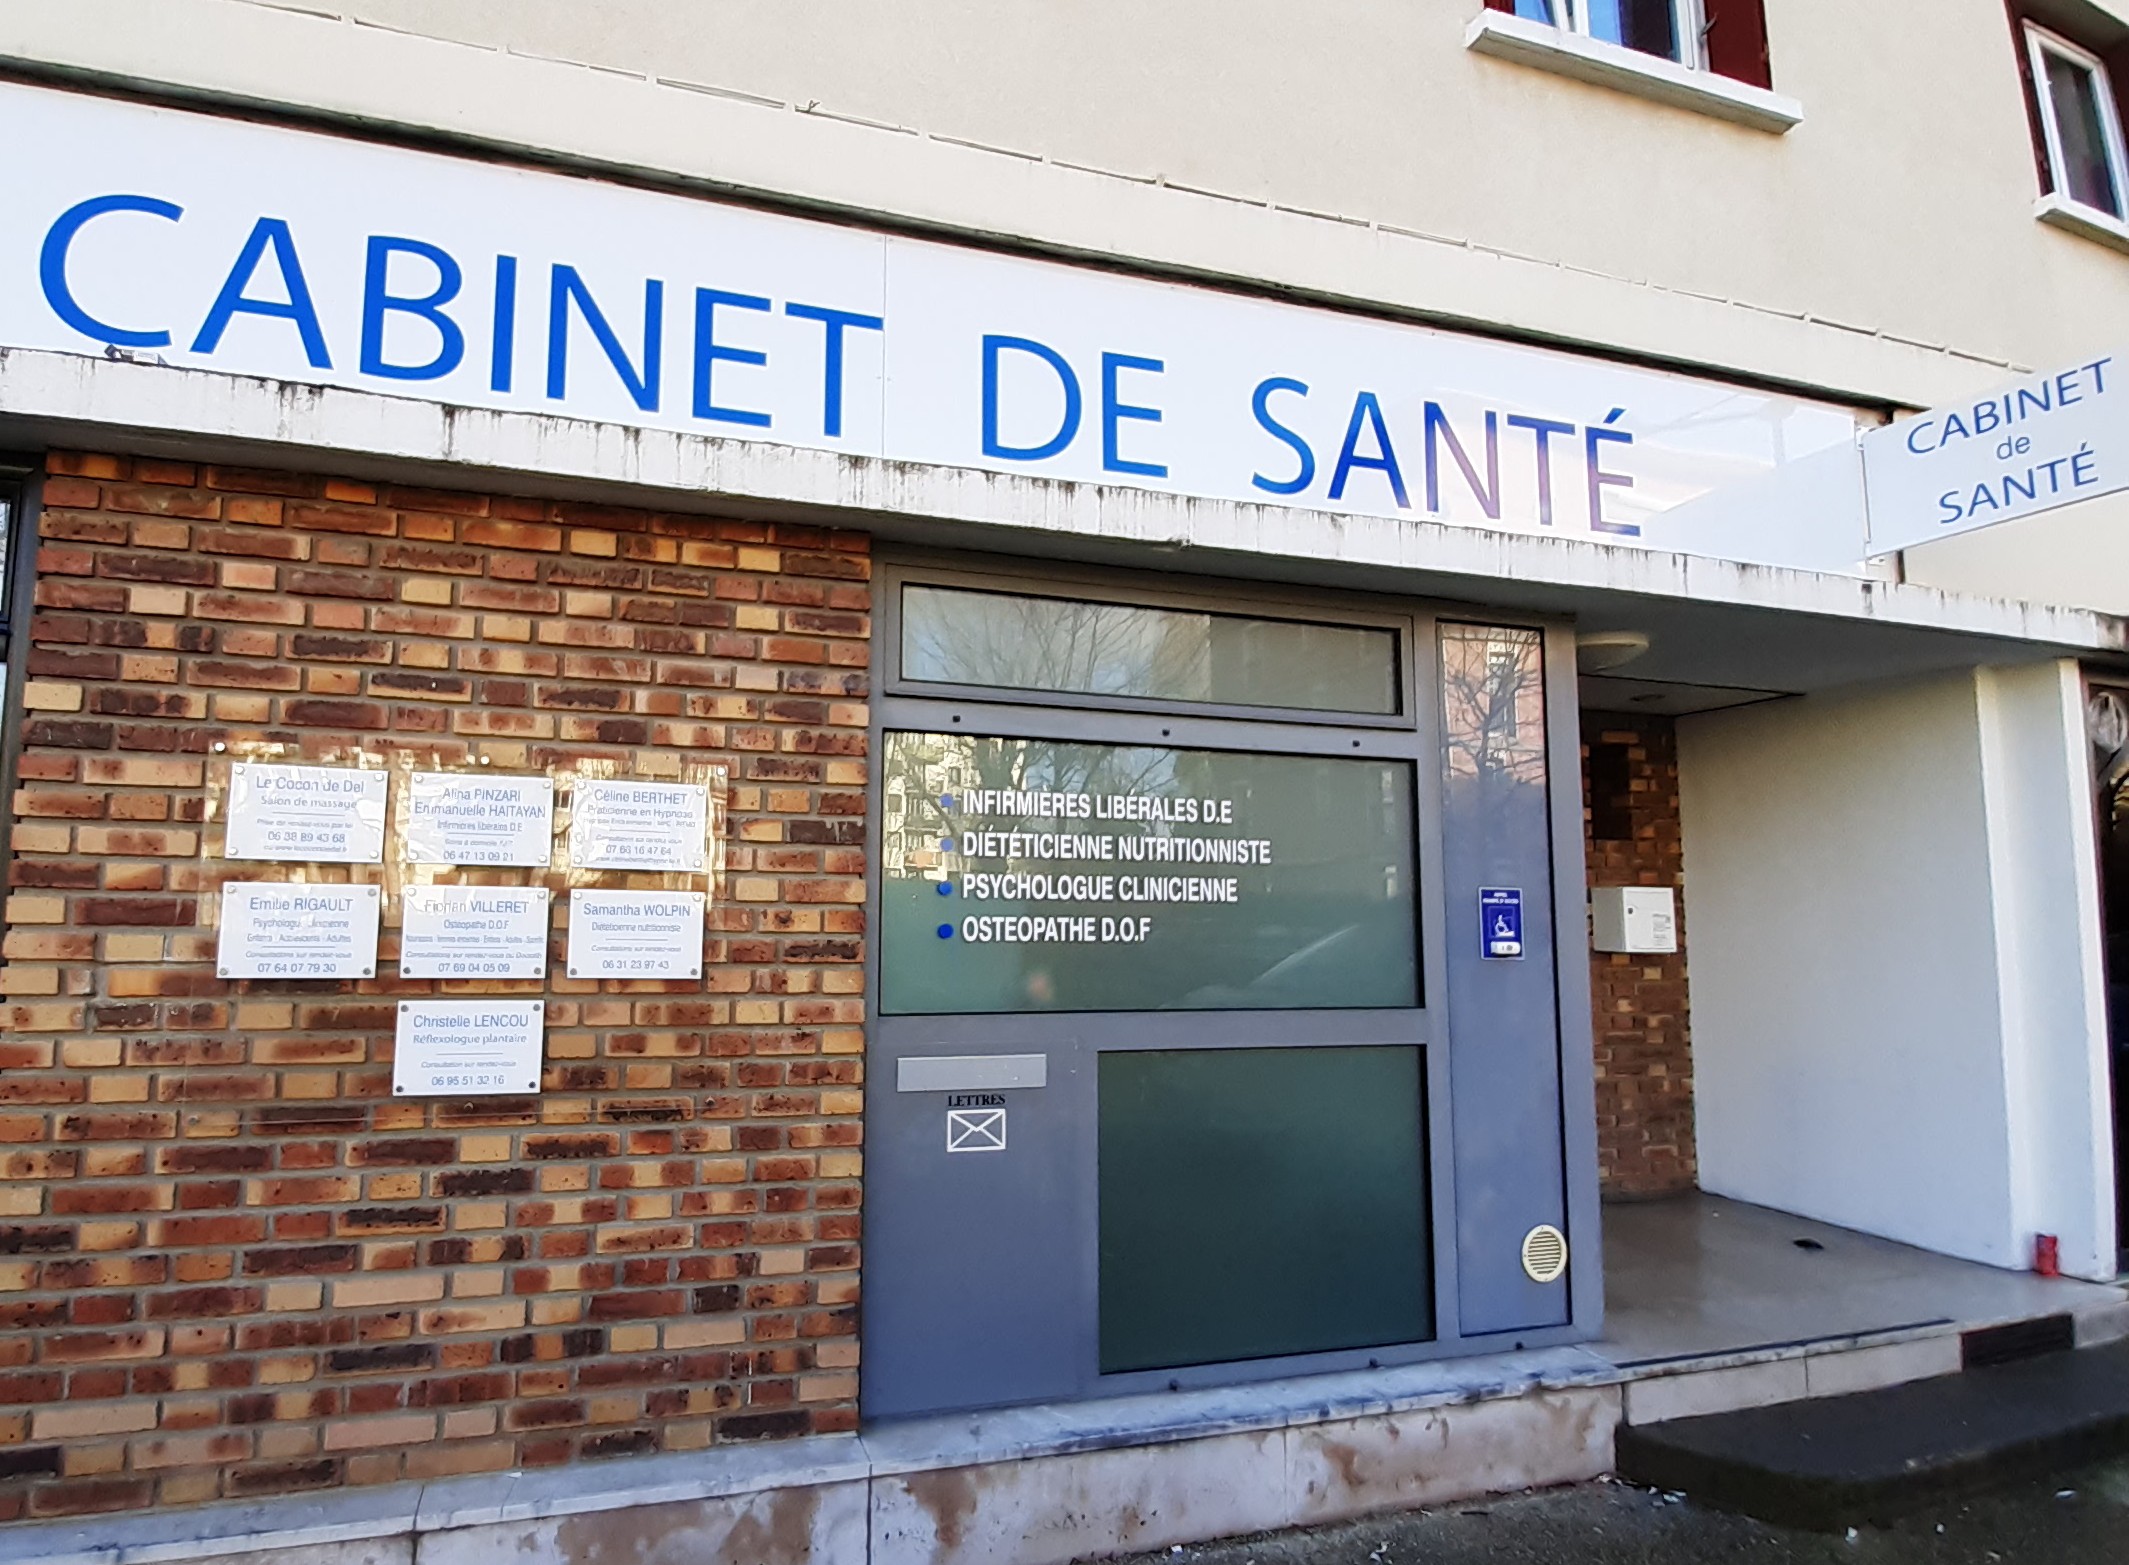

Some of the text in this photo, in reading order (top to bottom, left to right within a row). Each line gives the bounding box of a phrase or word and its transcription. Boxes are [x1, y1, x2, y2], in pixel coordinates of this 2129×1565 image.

[39, 194, 1642, 537] CABINET DE SANTÉ
[1906, 356, 2112, 455] CABINET
[1996, 436, 2031, 460] de
[1938, 441, 2099, 524] SANTÉ
[474, 788, 521, 802] PINZARI
[594, 788, 688, 805] Céline BERTHET
[962, 785, 1233, 825] INFIRMIÈRES LIBÉRALES D.E
[962, 824, 1272, 865] DIÉTÉTICIENNE NUTRITIONNISTE
[962, 873, 1239, 902] PSYCHOLOGUE CLINICIENNE
[294, 897, 354, 912] RIGAULT
[470, 900, 530, 914] VILLERET
[583, 902, 691, 917] Samantha WOLPIN
[962, 916, 1152, 943] OSTEOPATHE D.O.F
[257, 963, 337, 973] 07 64 07 79 30
[438, 963, 450, 972] 07
[468, 963, 480, 972] 04
[483, 963, 495, 972] 05
[602, 959, 614, 969] 06
[616, 959, 627, 969] 31
[630, 960, 642, 969] 23
[413, 1014, 529, 1028] Christelle LENCOU
[482, 1033, 527, 1046] plantaire
[462, 1075, 473, 1085] 51
[947, 1093, 1006, 1107] LETTRES
